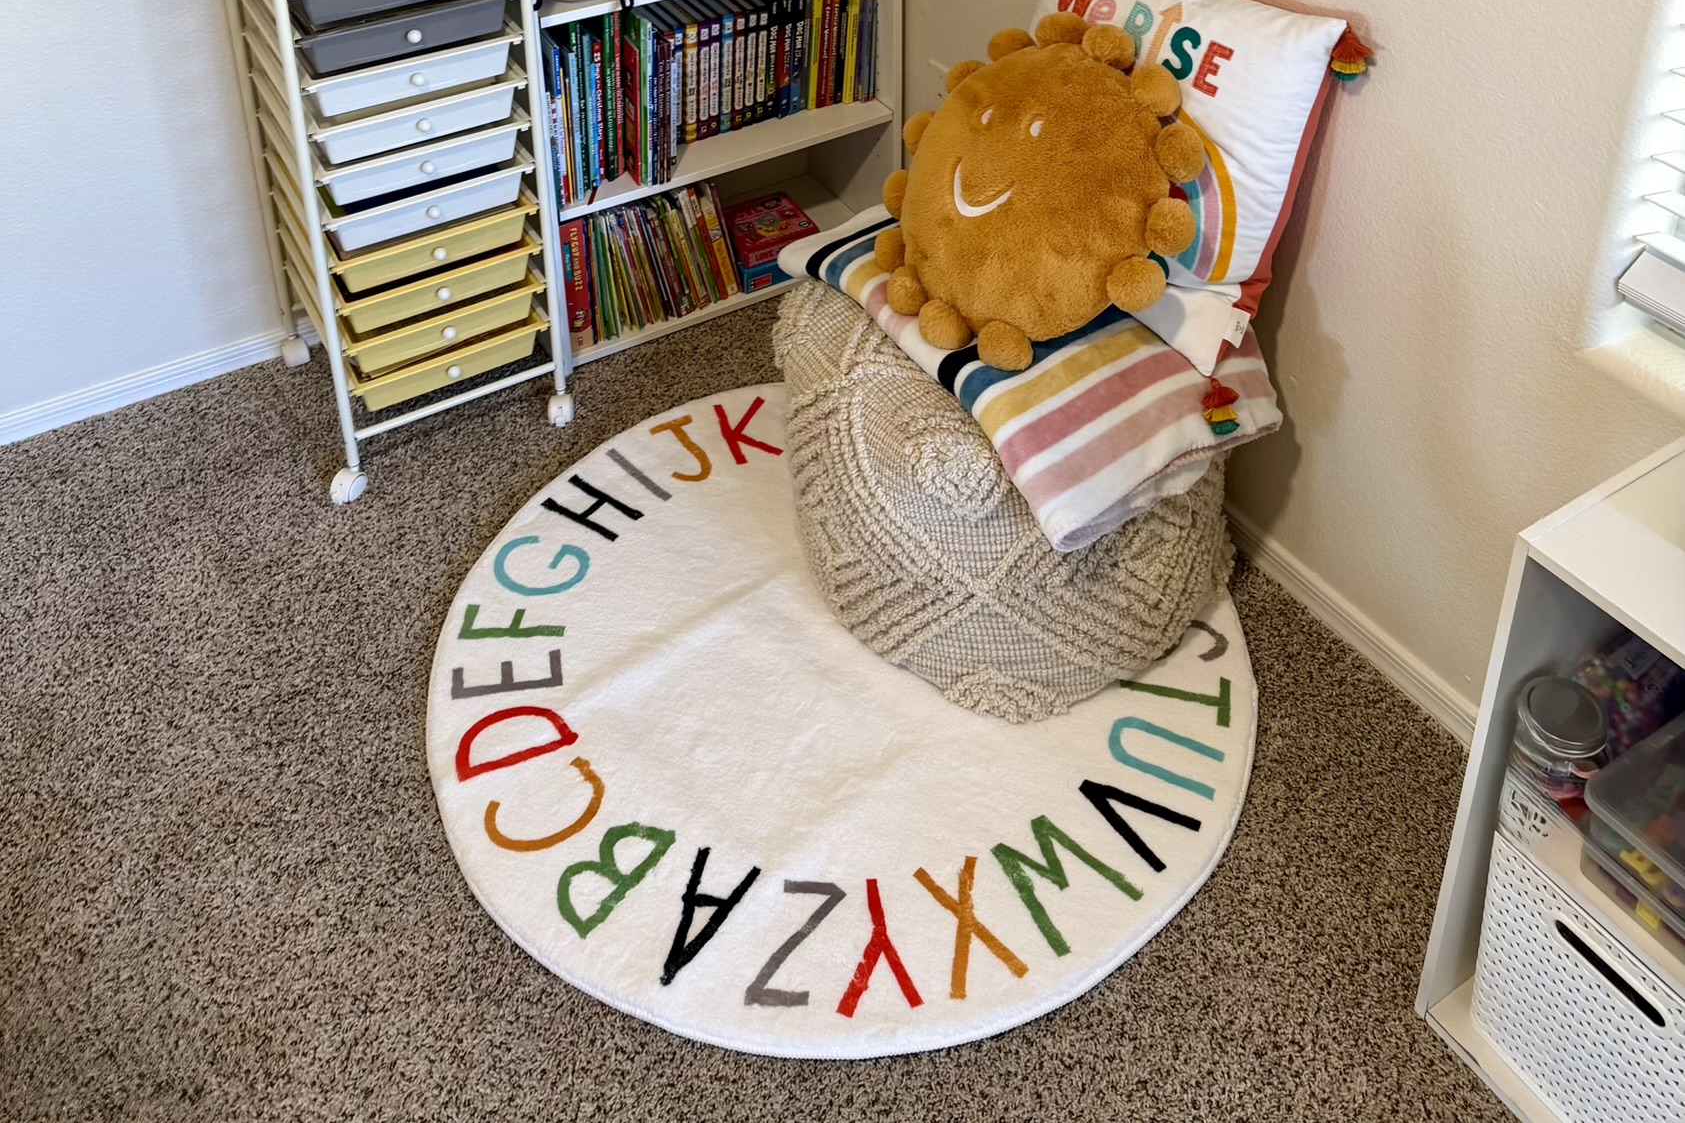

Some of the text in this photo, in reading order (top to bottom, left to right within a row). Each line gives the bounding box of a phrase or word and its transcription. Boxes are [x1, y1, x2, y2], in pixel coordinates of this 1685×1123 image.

[593, 51, 600, 62] 25
[593, 62, 601, 78] Days
[570, 228, 578, 241] FLY
[571, 242, 579, 256] GUY
[574, 270, 582, 290] BUZZ
